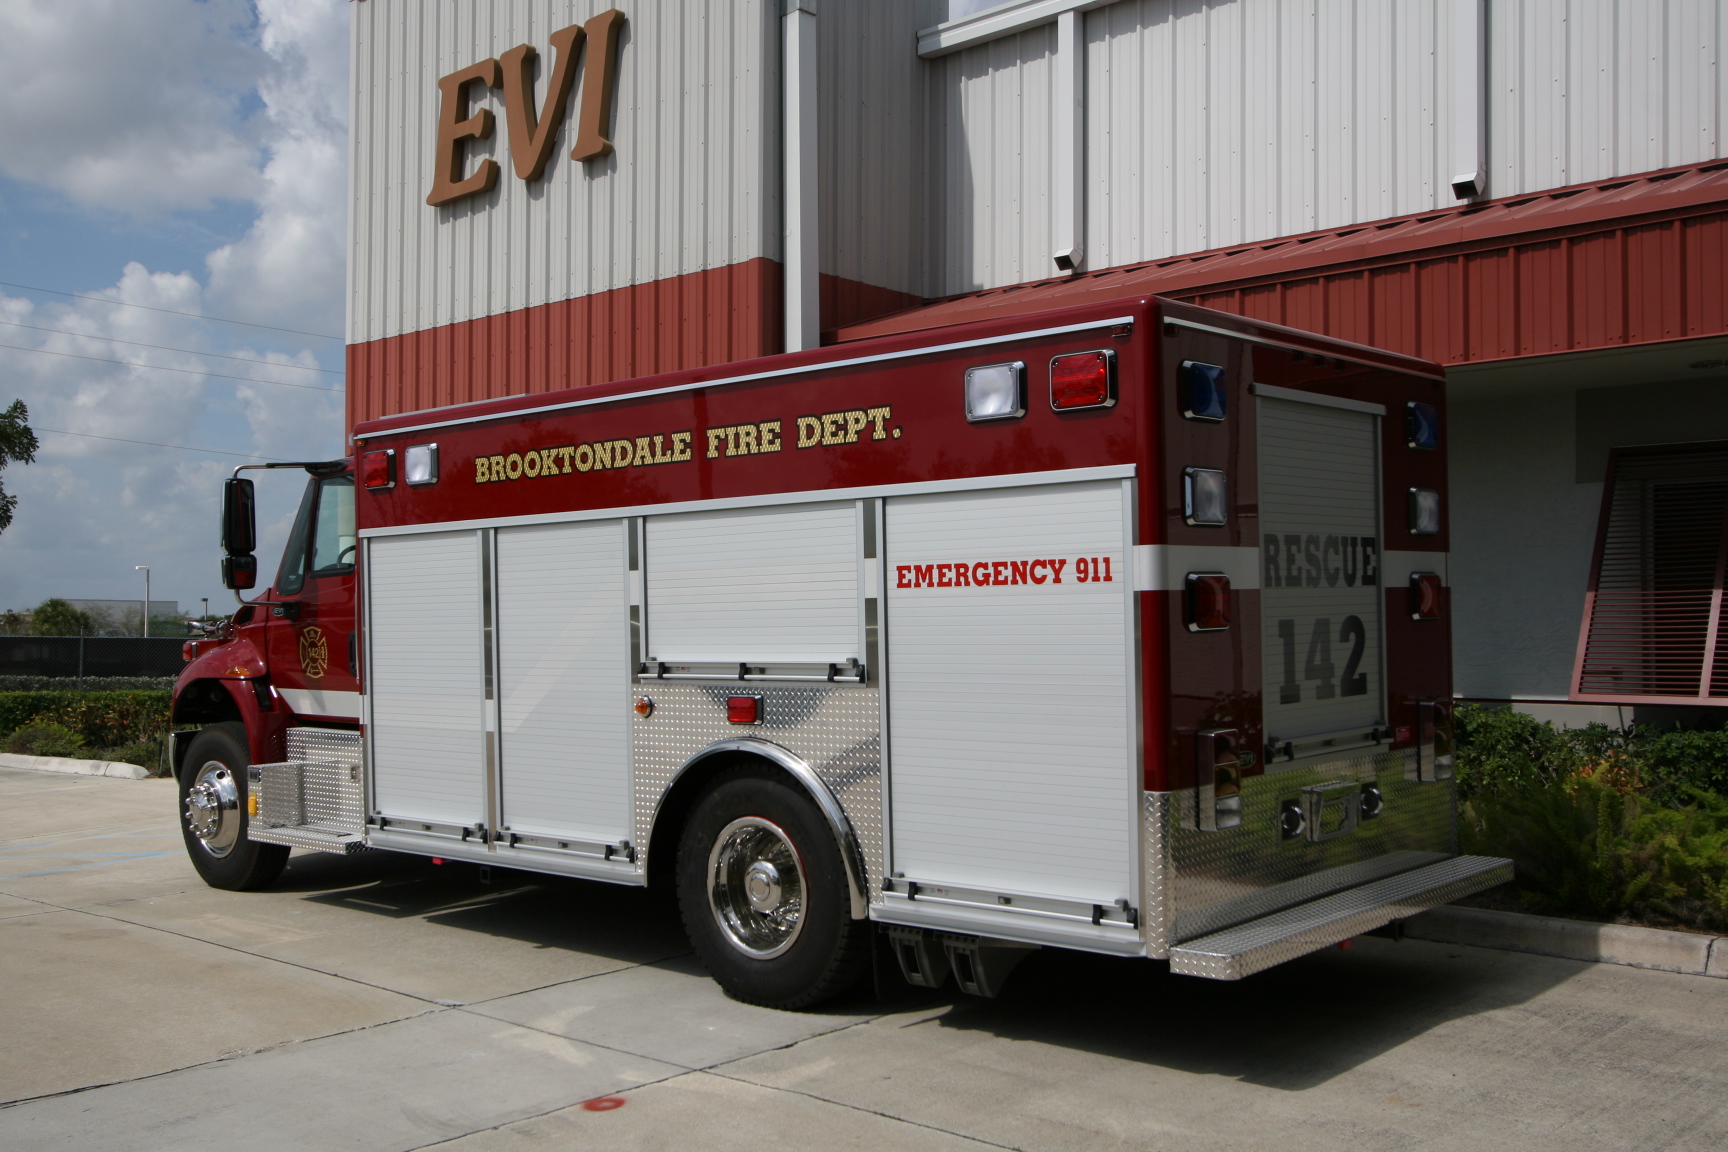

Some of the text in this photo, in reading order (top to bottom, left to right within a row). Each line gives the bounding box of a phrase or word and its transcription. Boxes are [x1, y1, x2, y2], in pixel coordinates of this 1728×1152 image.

[426, 8, 625, 207] EVI
[474, 406, 903, 483] BROOKTONDALE FIRE DEPT.
[896, 557, 1113, 588] EMERGENCY 911
[1263, 533, 1377, 588] RESCUE
[308, 647, 320, 658] 142
[1278, 615, 1368, 705] 142
